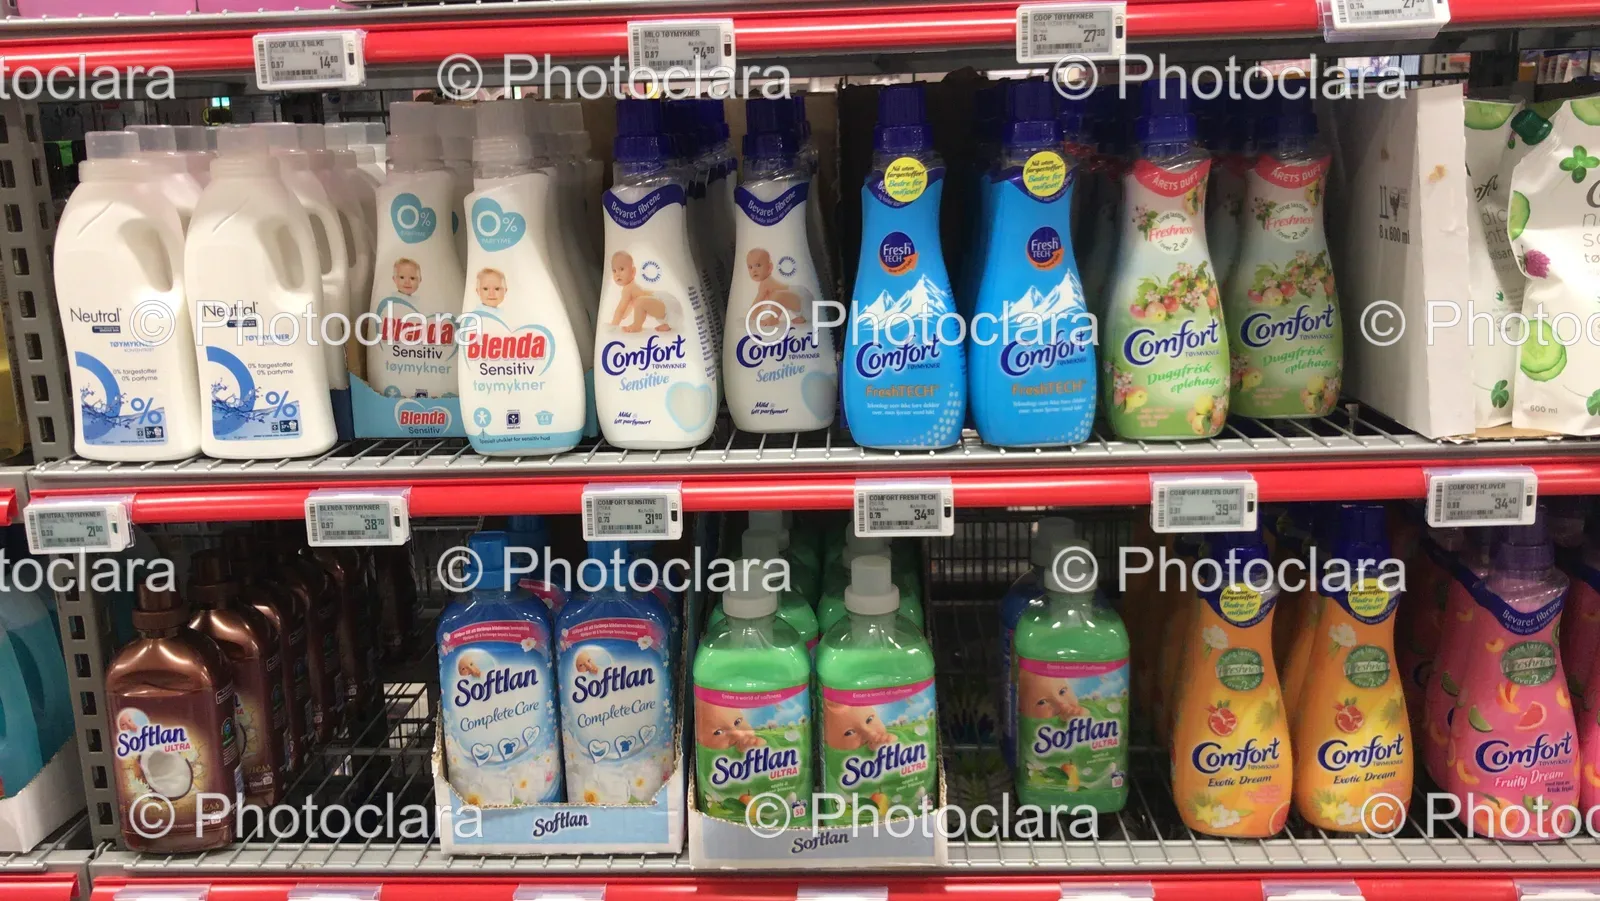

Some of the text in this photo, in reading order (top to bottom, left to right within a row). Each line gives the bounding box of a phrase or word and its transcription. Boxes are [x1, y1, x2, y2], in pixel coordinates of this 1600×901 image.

[1033, 13, 1052, 21] COOP
[662, 29, 700, 38] TØYMYKNER
[269, 40, 287, 49] COOP
[887, 178, 923, 188] Bedre for
[1151, 170, 1199, 191] ÅRETS DUFT
[1270, 167, 1300, 183] ÅRETS
[611, 192, 661, 220] Bevarer fibrene
[747, 190, 796, 217] Bevarer fibrene
[396, 204, 431, 230] 0%
[476, 210, 518, 237] 0%
[1264, 214, 1315, 232] Freshness
[480, 237, 511, 245] PARFYME
[1148, 224, 1193, 243] Freshness
[1291, 231, 1299, 240] 2
[1378, 224, 1410, 245] 8 x 600 ml
[883, 242, 912, 256] Fresh
[1031, 237, 1059, 251] Fresh
[1173, 242, 1180, 252] 2
[884, 254, 902, 263] TECH
[1032, 250, 1051, 258] TECH
[69, 307, 120, 323] Neutral
[1240, 303, 1335, 348] Comfort
[467, 332, 546, 359] Blenda
[1123, 318, 1219, 366] Comfort
[392, 345, 443, 359] Sensitiv
[601, 334, 686, 376] Comfort
[856, 333, 940, 378] Comfort
[1262, 344, 1326, 367] Duggfrisk
[385, 360, 452, 376] tøymykner
[479, 362, 535, 376] Sensitiv
[755, 361, 806, 383] Sensitive
[1147, 361, 1213, 386] Duggfrisk
[1284, 358, 1334, 375] eplehage
[473, 378, 546, 395] tøymykner
[619, 371, 670, 392] Sensitive
[1170, 376, 1221, 394] eplehage
[400, 410, 446, 425] Blenda
[1529, 404, 1559, 414] 600 ml
[408, 426, 441, 434] Sensitiv
[1169, 488, 1200, 496] COMFORT
[1447, 483, 1479, 491] COMFORT
[319, 503, 380, 512] BLENDA TØYMYKNER
[1502, 609, 1535, 627] Bevarer
[1535, 600, 1561, 623] fibrene
[454, 667, 539, 707] Softlan
[572, 665, 656, 704] Softlan
[1241, 680, 1249, 690] 2
[1368, 678, 1376, 687] 2
[1531, 674, 1541, 684] 2
[460, 700, 540, 733] Complete Care
[577, 699, 656, 729] Complete Care
[117, 724, 187, 757] Softlan
[1034, 717, 1119, 754] Softlan
[1091, 738, 1118, 750] ULTRA
[164, 742, 191, 753] ULTRA
[1191, 737, 1280, 774] Comfort
[1317, 733, 1404, 772] Comfort
[1475, 731, 1573, 773] Comfort
[711, 746, 799, 785] Softlan
[769, 766, 798, 780] ULTRA
[841, 742, 927, 787] Softlan
[900, 760, 927, 776] ULTRA
[1207, 775, 1272, 788] Exotic Dream
[1333, 770, 1396, 785] Exotic Dream
[1494, 769, 1564, 791] Fruity Dream
[795, 808, 804, 816] 50
[532, 810, 589, 837] Softlan
[791, 831, 850, 854] Softlan
